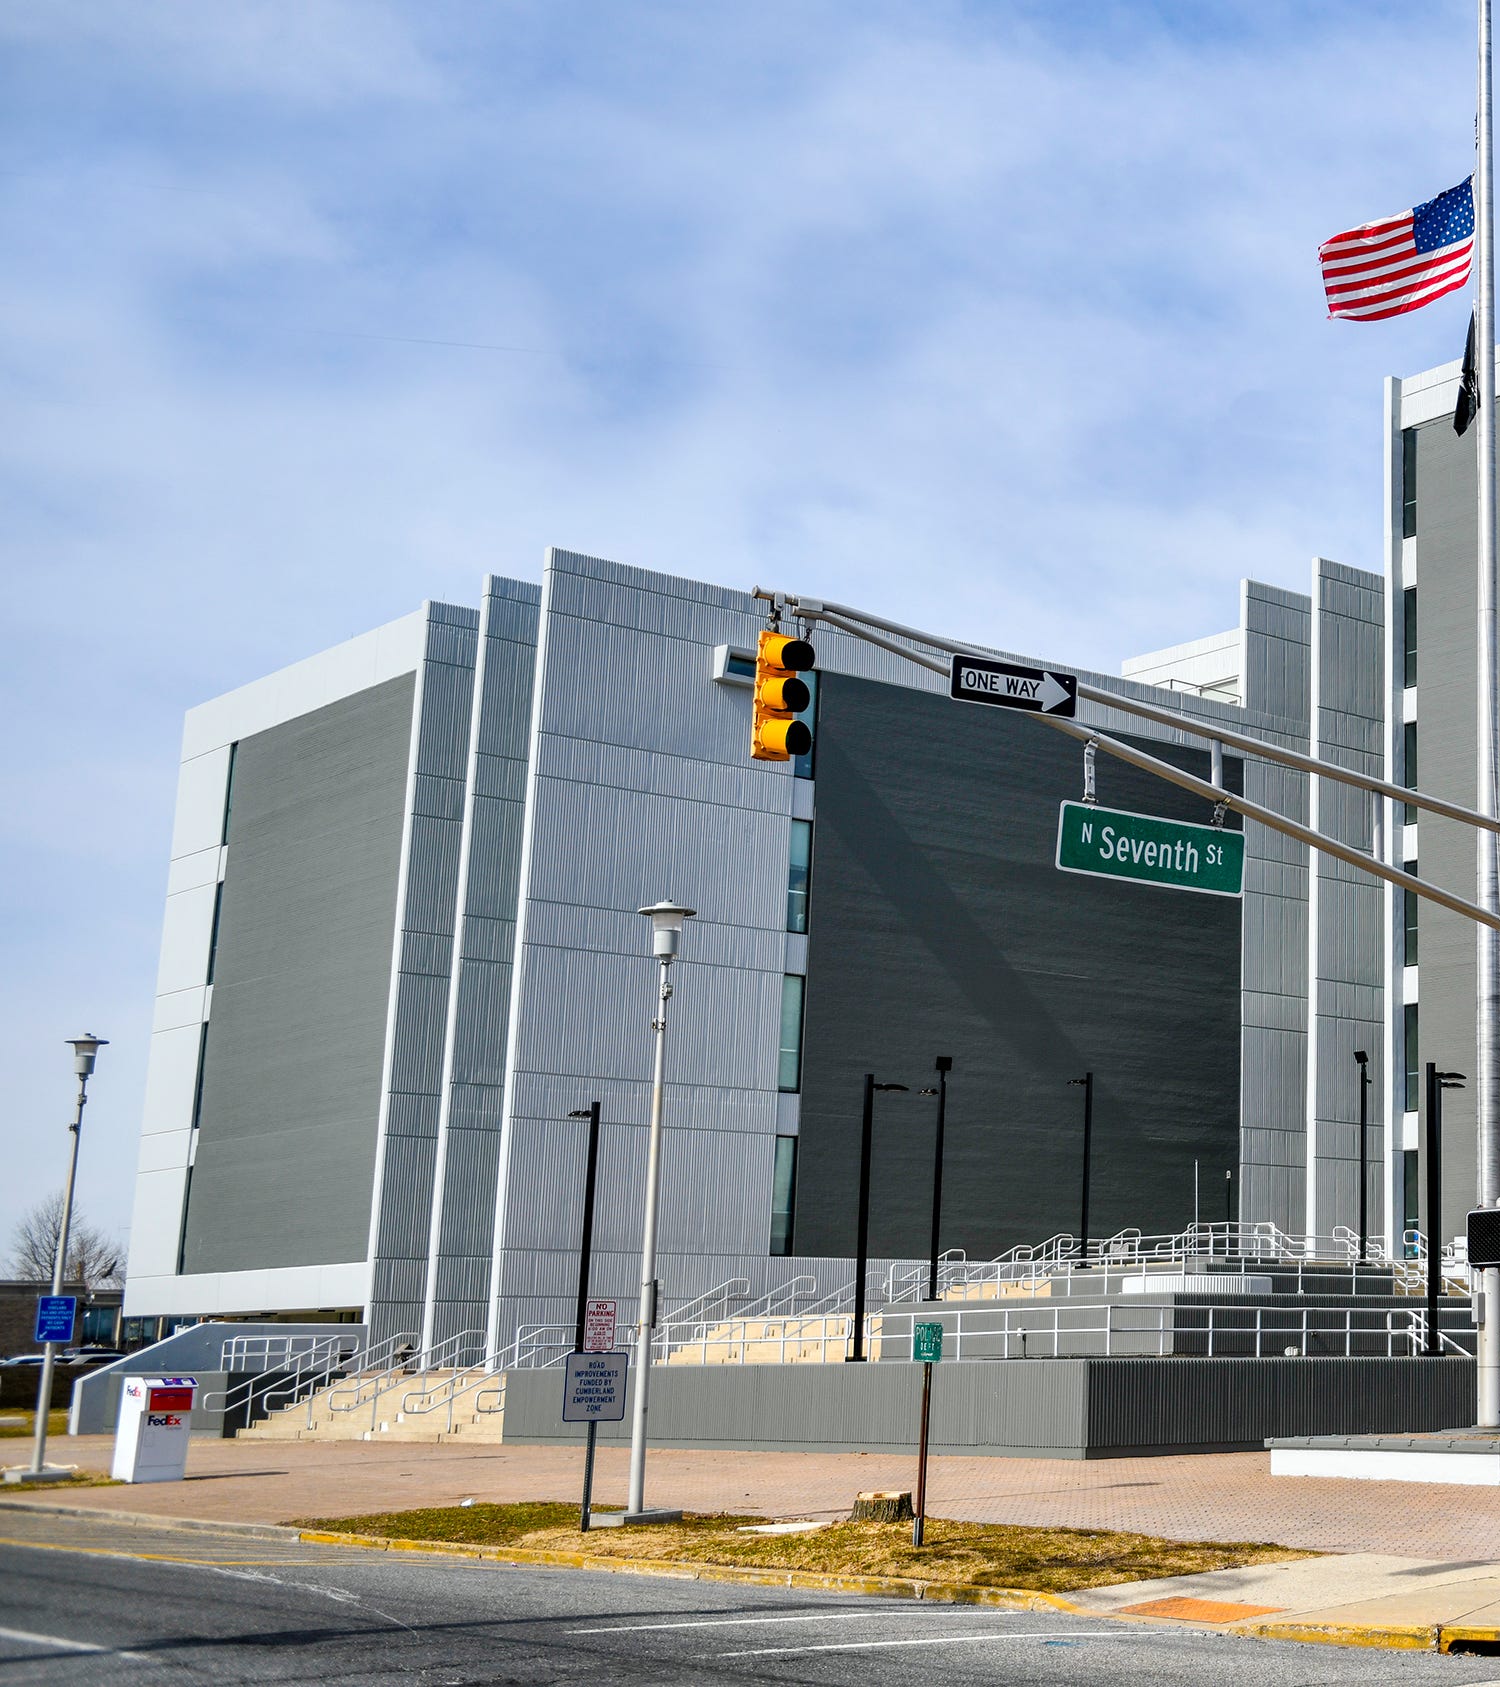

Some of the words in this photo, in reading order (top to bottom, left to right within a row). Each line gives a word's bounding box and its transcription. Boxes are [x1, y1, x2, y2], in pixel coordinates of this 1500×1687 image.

[965, 670, 1000, 691] ONE
[1006, 677, 1041, 698] WAY
[1081, 822, 1093, 843] N
[1100, 826, 1199, 873] Seventh
[1206, 844, 1224, 866] St
[588, 1361, 606, 1369] ROAD
[574, 1370, 619, 1378] IMPROVEMENTS
[575, 1387, 615, 1395] CUMBERLAND
[572, 1396, 617, 1404] EMPOWERMENT
[586, 1404, 602, 1412] ZONE
[147, 1414, 182, 1426] FedEx
